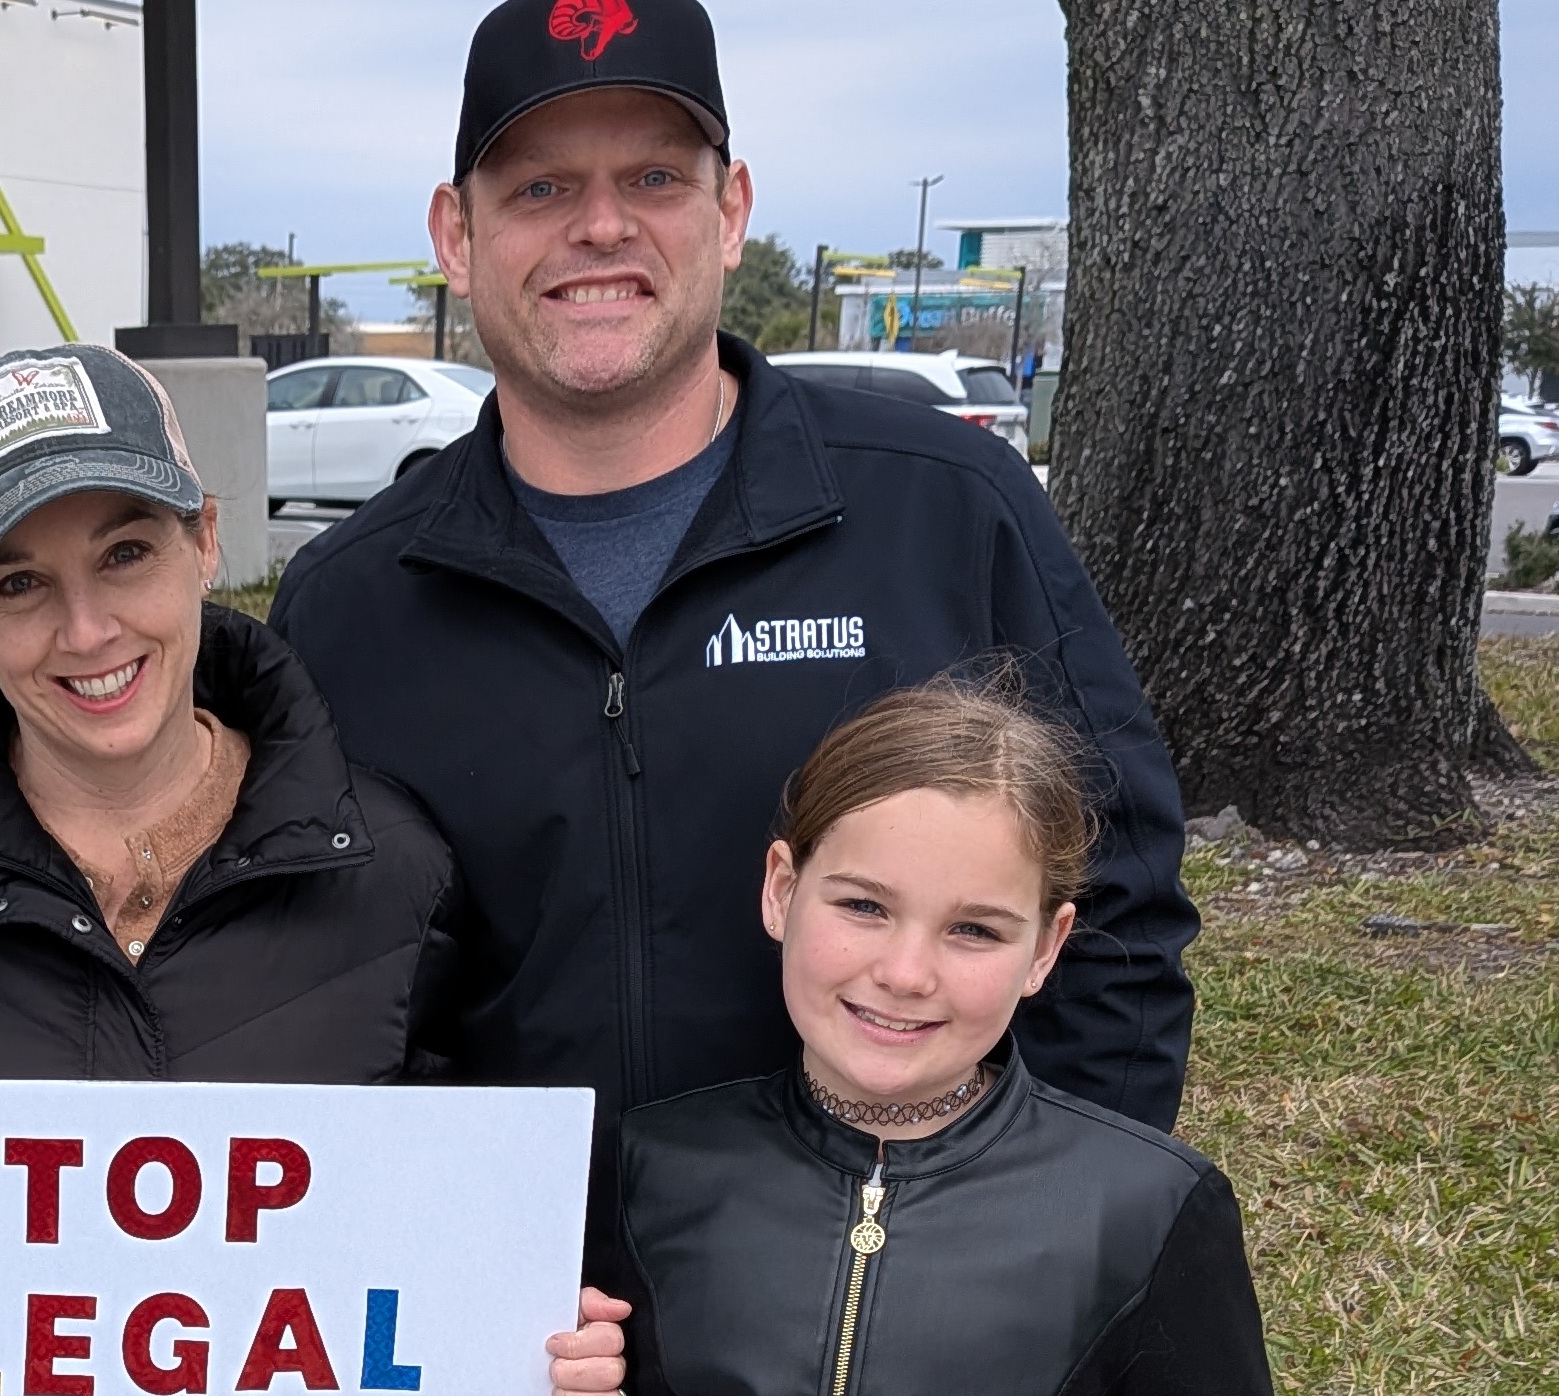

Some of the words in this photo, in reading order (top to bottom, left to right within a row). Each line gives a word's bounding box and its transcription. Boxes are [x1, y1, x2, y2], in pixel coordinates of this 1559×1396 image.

[53, 401, 78, 411] SPA
[755, 616, 864, 651] STRATUS
[757, 650, 805, 662] BUILDING
[807, 647, 866, 659] SOLUTIONS
